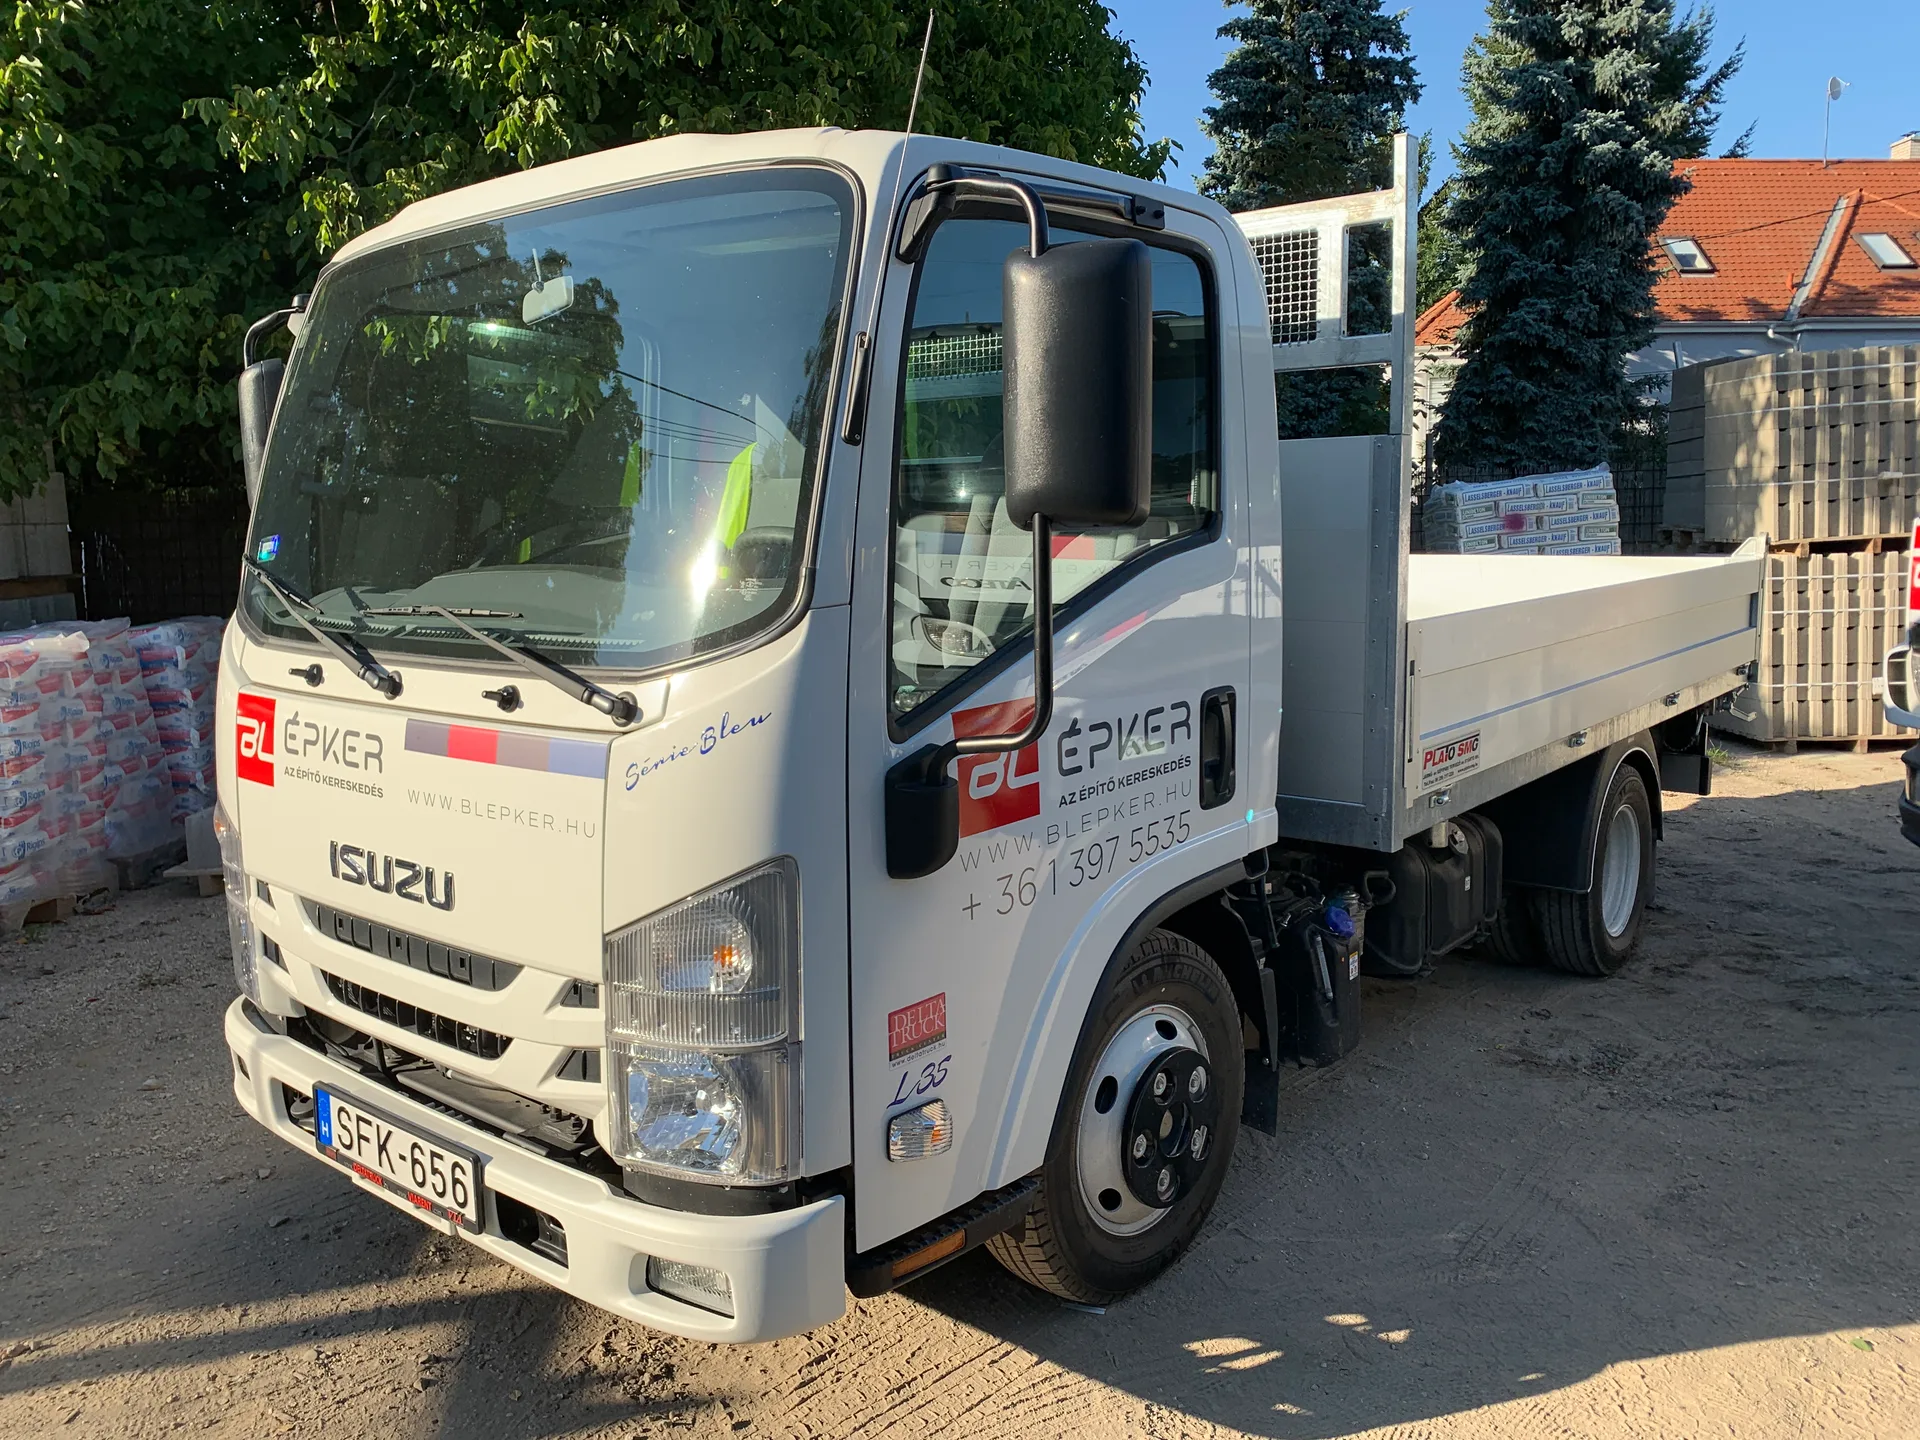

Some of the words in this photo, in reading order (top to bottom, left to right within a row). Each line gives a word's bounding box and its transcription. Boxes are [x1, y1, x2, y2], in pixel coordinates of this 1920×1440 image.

[1465, 490, 1502, 502] LASSELSBERGER
[1507, 486, 1522, 496] KNAUF
[1545, 482, 1583, 493] LASSELSBERGER
[1587, 479, 1602, 488] KNAUF
[1507, 502, 1546, 512] LASSELSBERGER
[1549, 500, 1565, 509] KNAUF
[1551, 514, 1588, 526] LASSELSBERGER
[1593, 511, 1608, 520] KNAUF
[1468, 523, 1505, 535] LASSELSBERGER
[1510, 535, 1547, 545] LASSELSBERGER
[1551, 533, 1567, 541] KNAUF
[1595, 544, 1610, 553] KNAUF
[284, 711, 384, 774] ÉPKER
[700, 711, 772, 755] Bleu
[1057, 700, 1191, 777] ÉPKER
[1457, 738, 1479, 757] SMG
[284, 766, 295, 778] AZ
[296, 766, 321, 784] ÉPÍTŐ
[322, 775, 384, 799] KERESKEDÉS
[1059, 791, 1077, 808] AZ
[1079, 776, 1116, 802] ÉPÍTŐ
[1118, 754, 1191, 790] KERESKEDÉS
[407, 788, 596, 839] WWW.BLEPKER.HU
[959, 778, 1192, 873] WWW.BLEPKER.HU
[329, 840, 456, 912] ISUZU
[996, 867, 1037, 915] 36
[1048, 859, 1057, 895] 1
[1069, 835, 1120, 888] 397
[1128, 809, 1191, 863] 5535
[894, 998, 945, 1031] DELTA
[889, 1015, 945, 1048] TRUCK
[886, 1054, 952, 1109] L35
[321, 1121, 330, 1138] H
[337, 1105, 469, 1210] SFK-656
